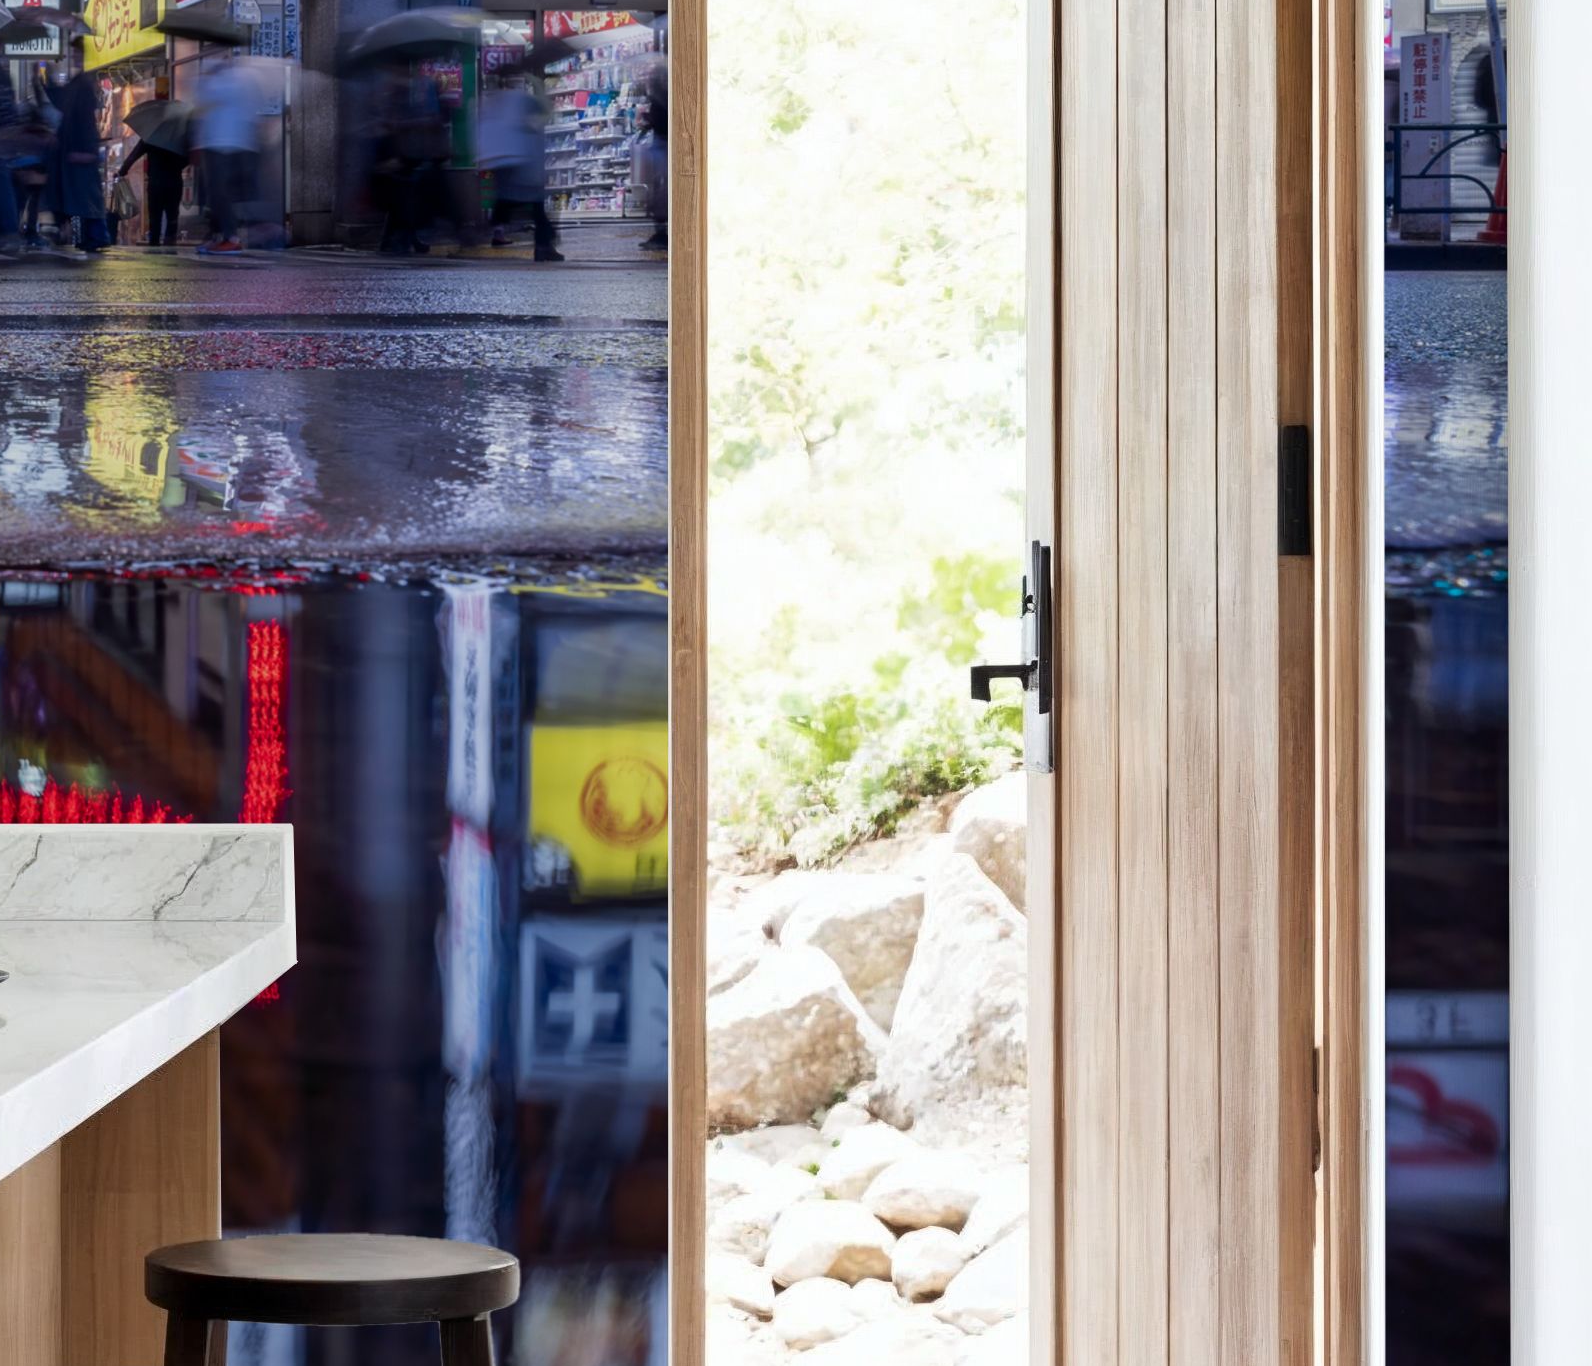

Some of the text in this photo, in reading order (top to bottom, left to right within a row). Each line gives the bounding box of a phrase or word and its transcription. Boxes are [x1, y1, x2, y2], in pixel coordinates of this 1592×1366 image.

[1412, 43, 1428, 119] 駐停車禁止
